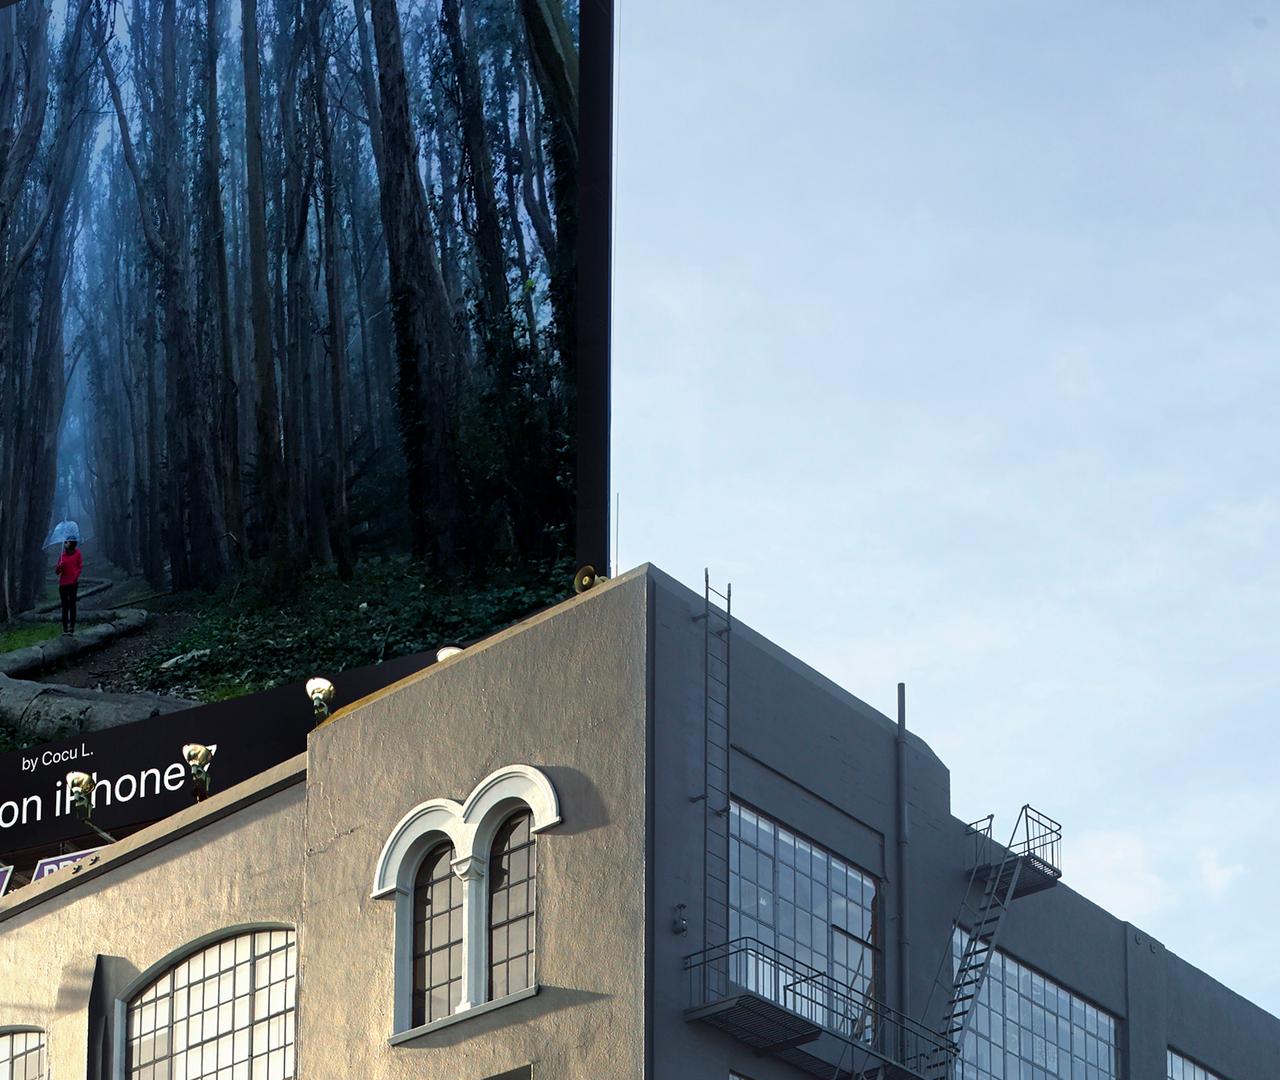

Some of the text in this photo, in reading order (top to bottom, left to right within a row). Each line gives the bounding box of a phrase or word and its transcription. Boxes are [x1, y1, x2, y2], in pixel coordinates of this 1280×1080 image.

[21, 742, 94, 772] by Cocu L.
